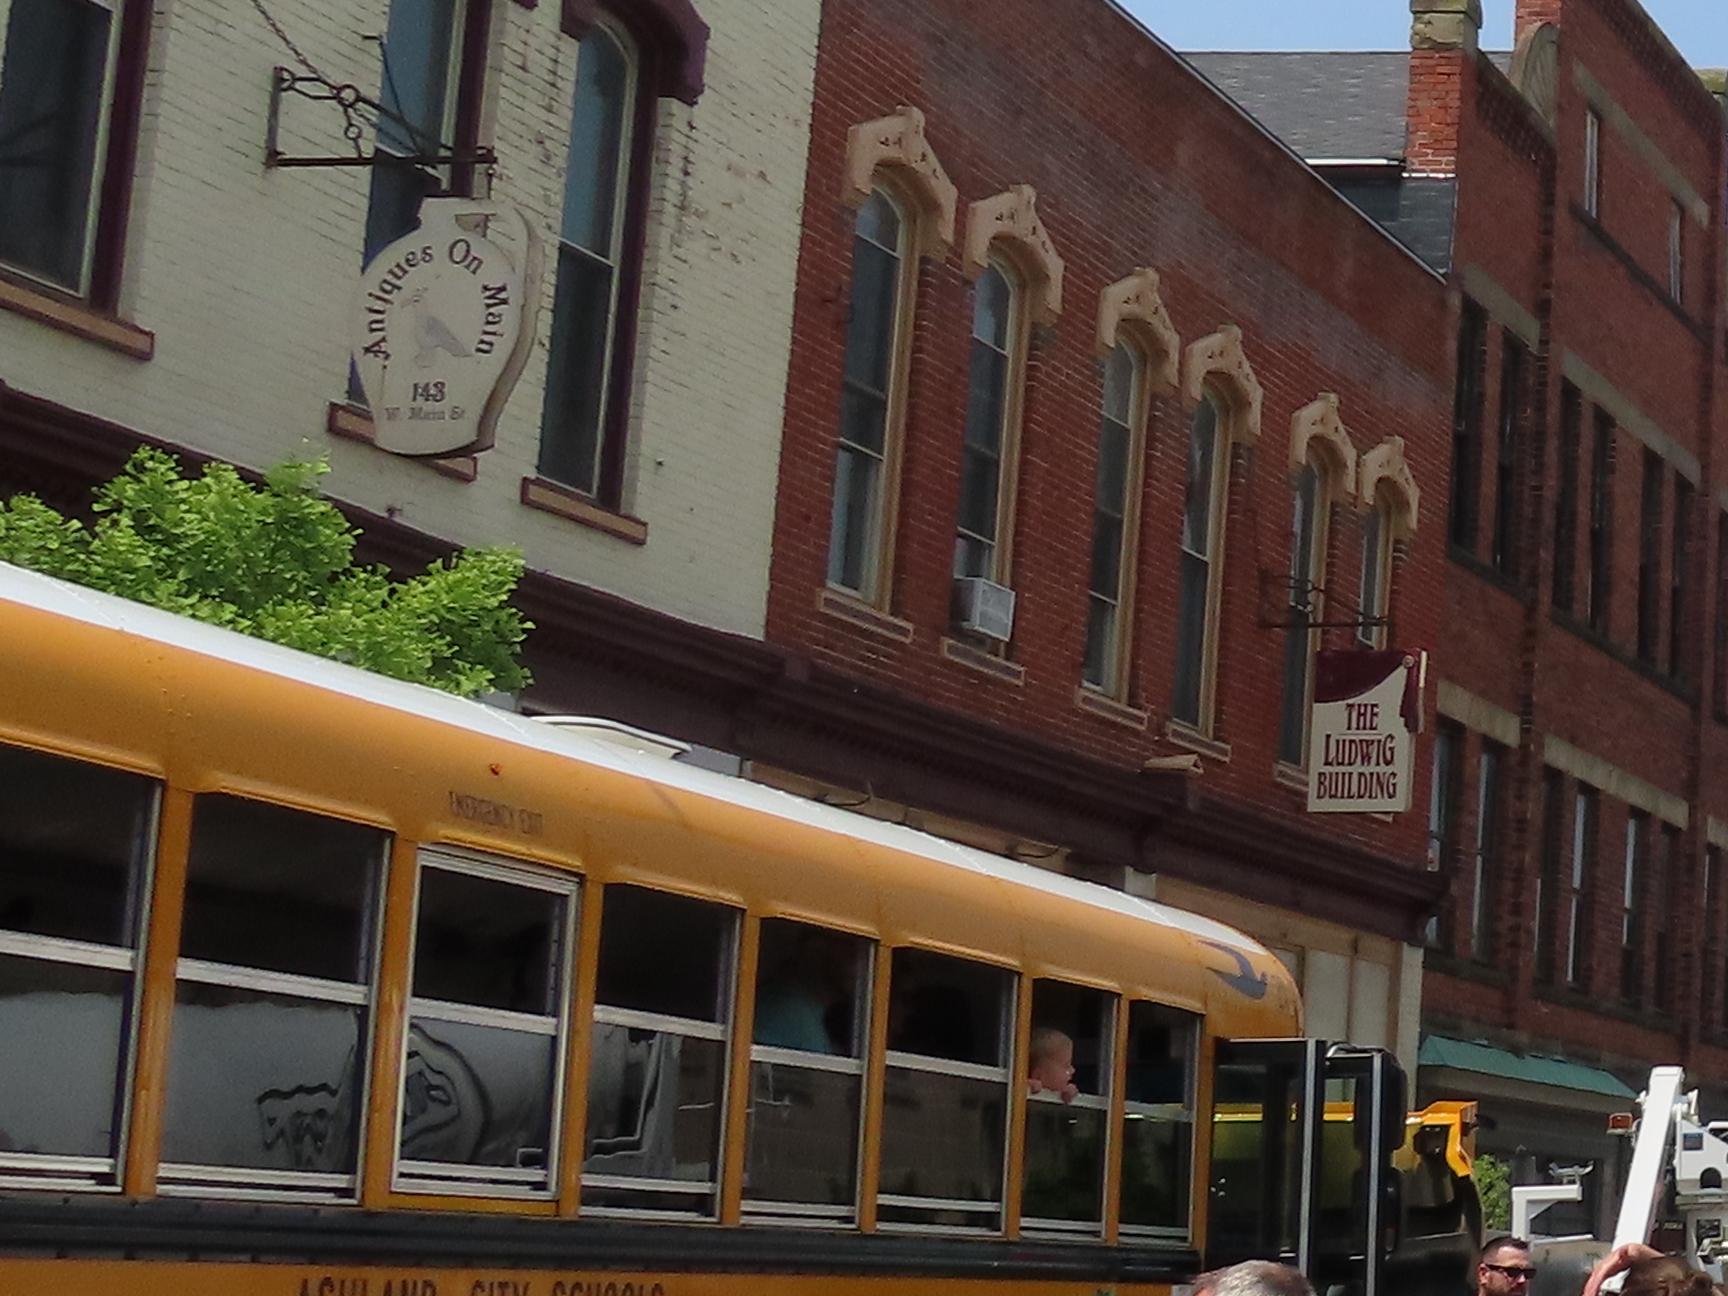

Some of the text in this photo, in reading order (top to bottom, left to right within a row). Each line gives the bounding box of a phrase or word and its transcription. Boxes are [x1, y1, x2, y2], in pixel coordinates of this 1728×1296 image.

[362, 238, 510, 361] Antiques On Main
[412, 381, 446, 403] 143
[1345, 703, 1379, 731] THE
[1323, 733, 1396, 766] LUDWIG
[1317, 771, 1397, 800] BUILDING
